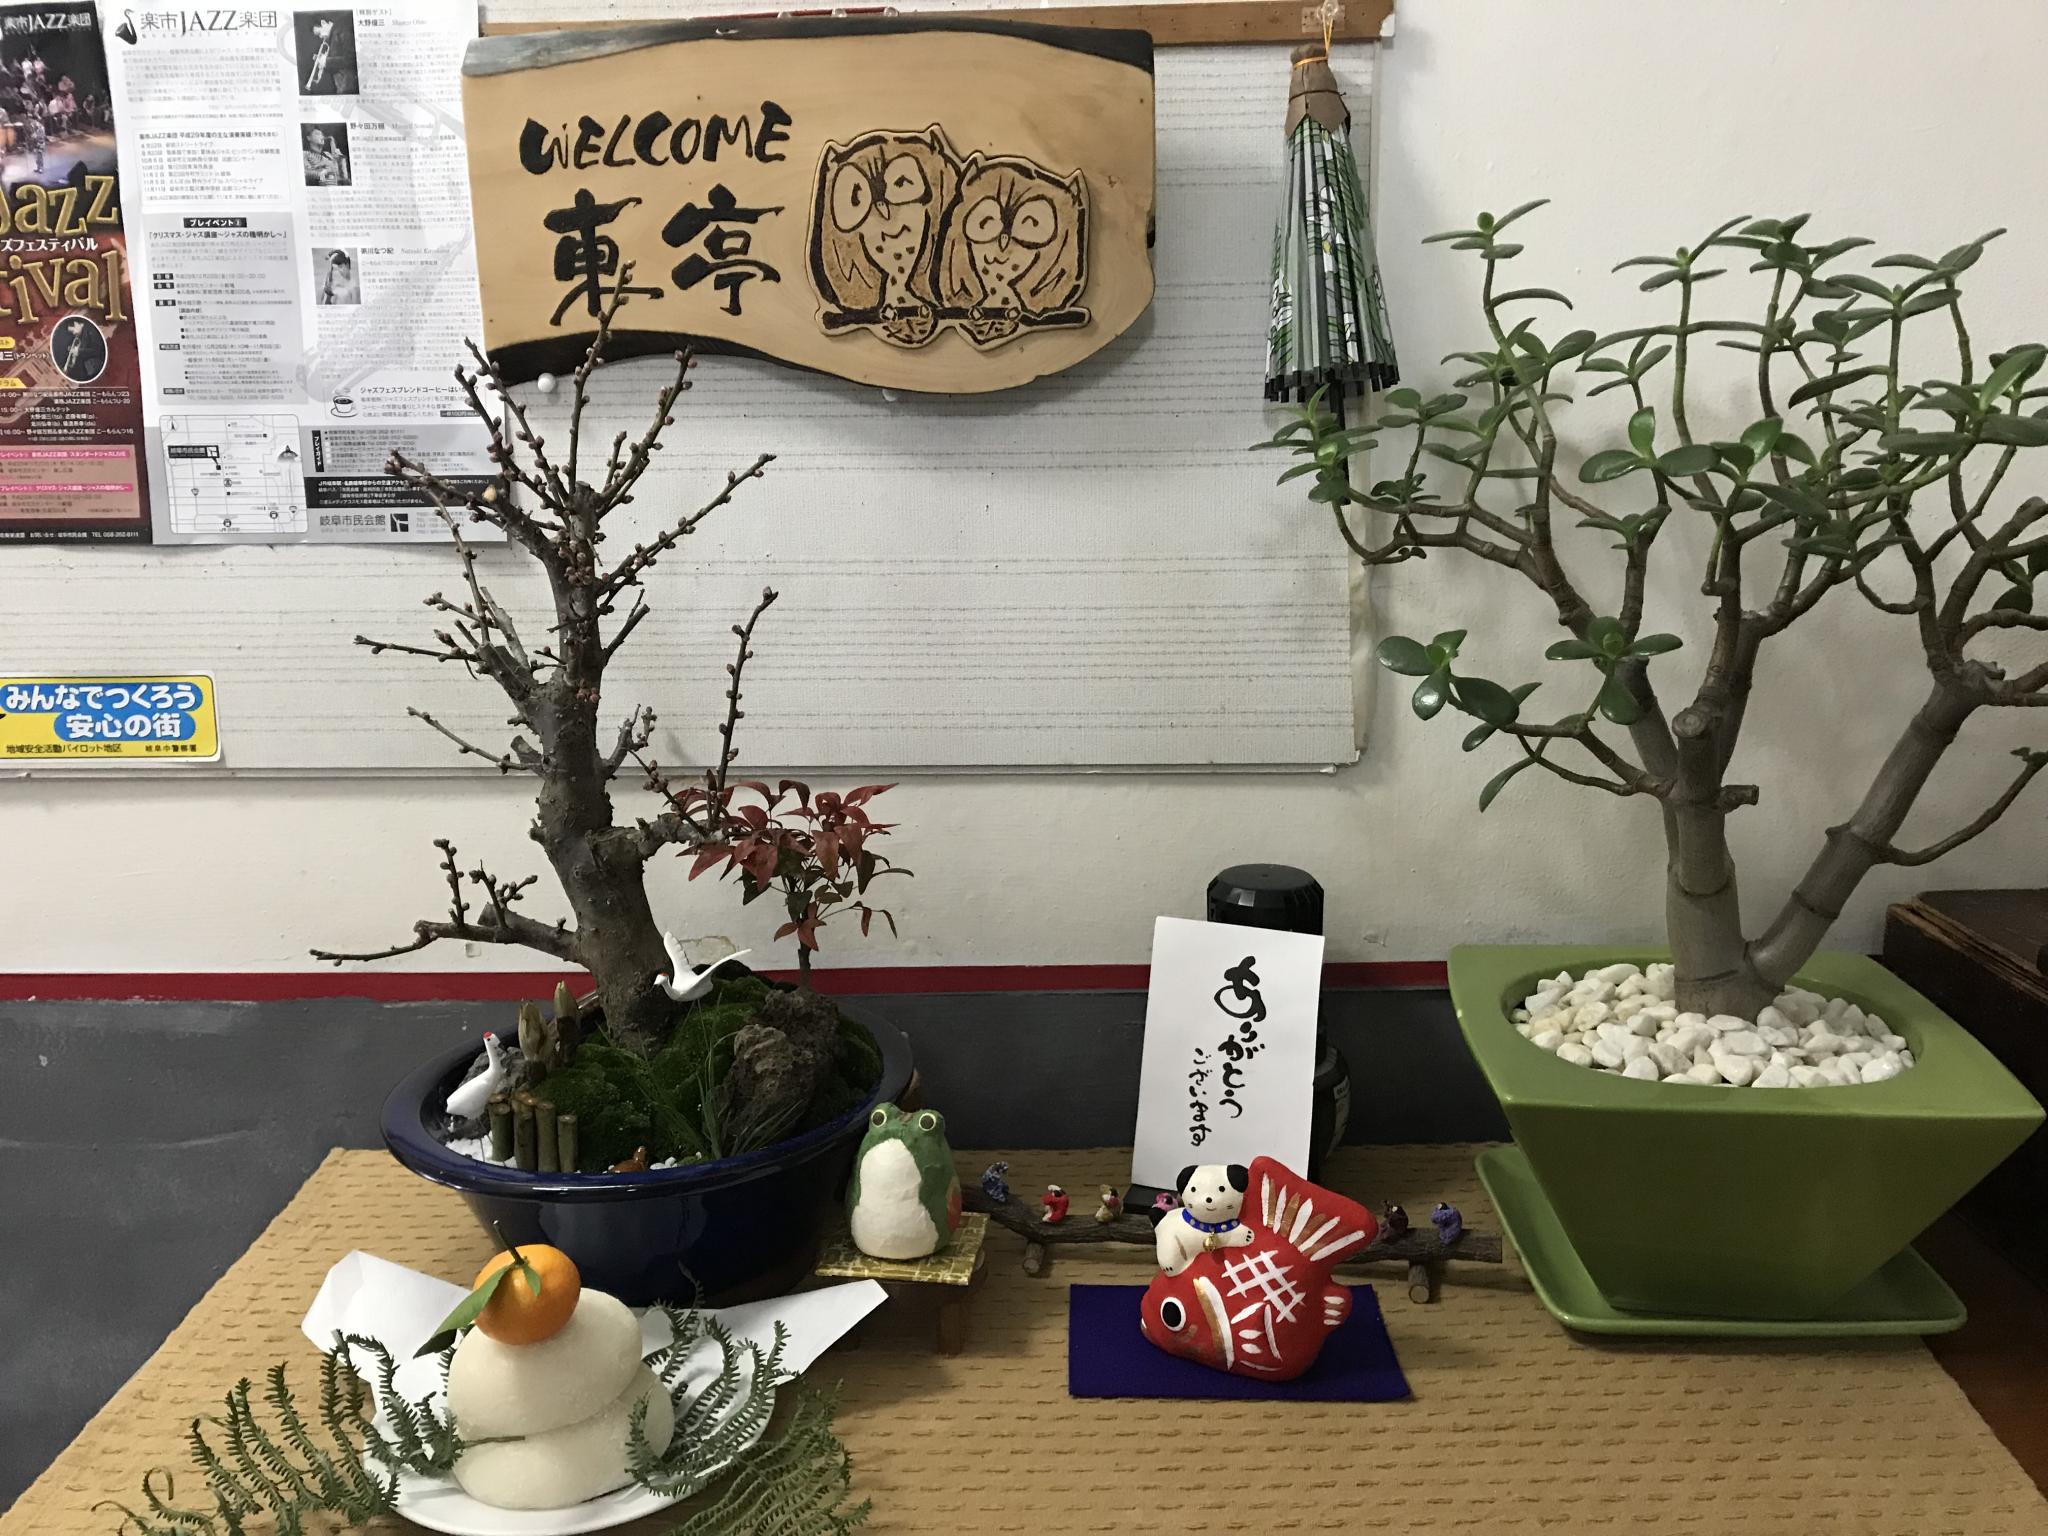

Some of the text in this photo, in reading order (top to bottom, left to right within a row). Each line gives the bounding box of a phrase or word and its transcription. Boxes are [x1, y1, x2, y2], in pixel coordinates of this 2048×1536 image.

[4, 13, 91, 33] 楽市JAZZ楽団
[140, 10, 278, 36] 楽市JAZZ楽団
[519, 100, 792, 175] WELCOME
[543, 183, 785, 326] 東亭
[319, 514, 386, 527] 岐阜市民会館
[6, 684, 196, 711] みんなでつくろう
[66, 713, 181, 739] 安心の街
[6, 744, 123, 754] 地域安全活動パイロット地区
[1213, 955, 1268, 1119] ありがとう
[1187, 1047, 1214, 1147] ございます
